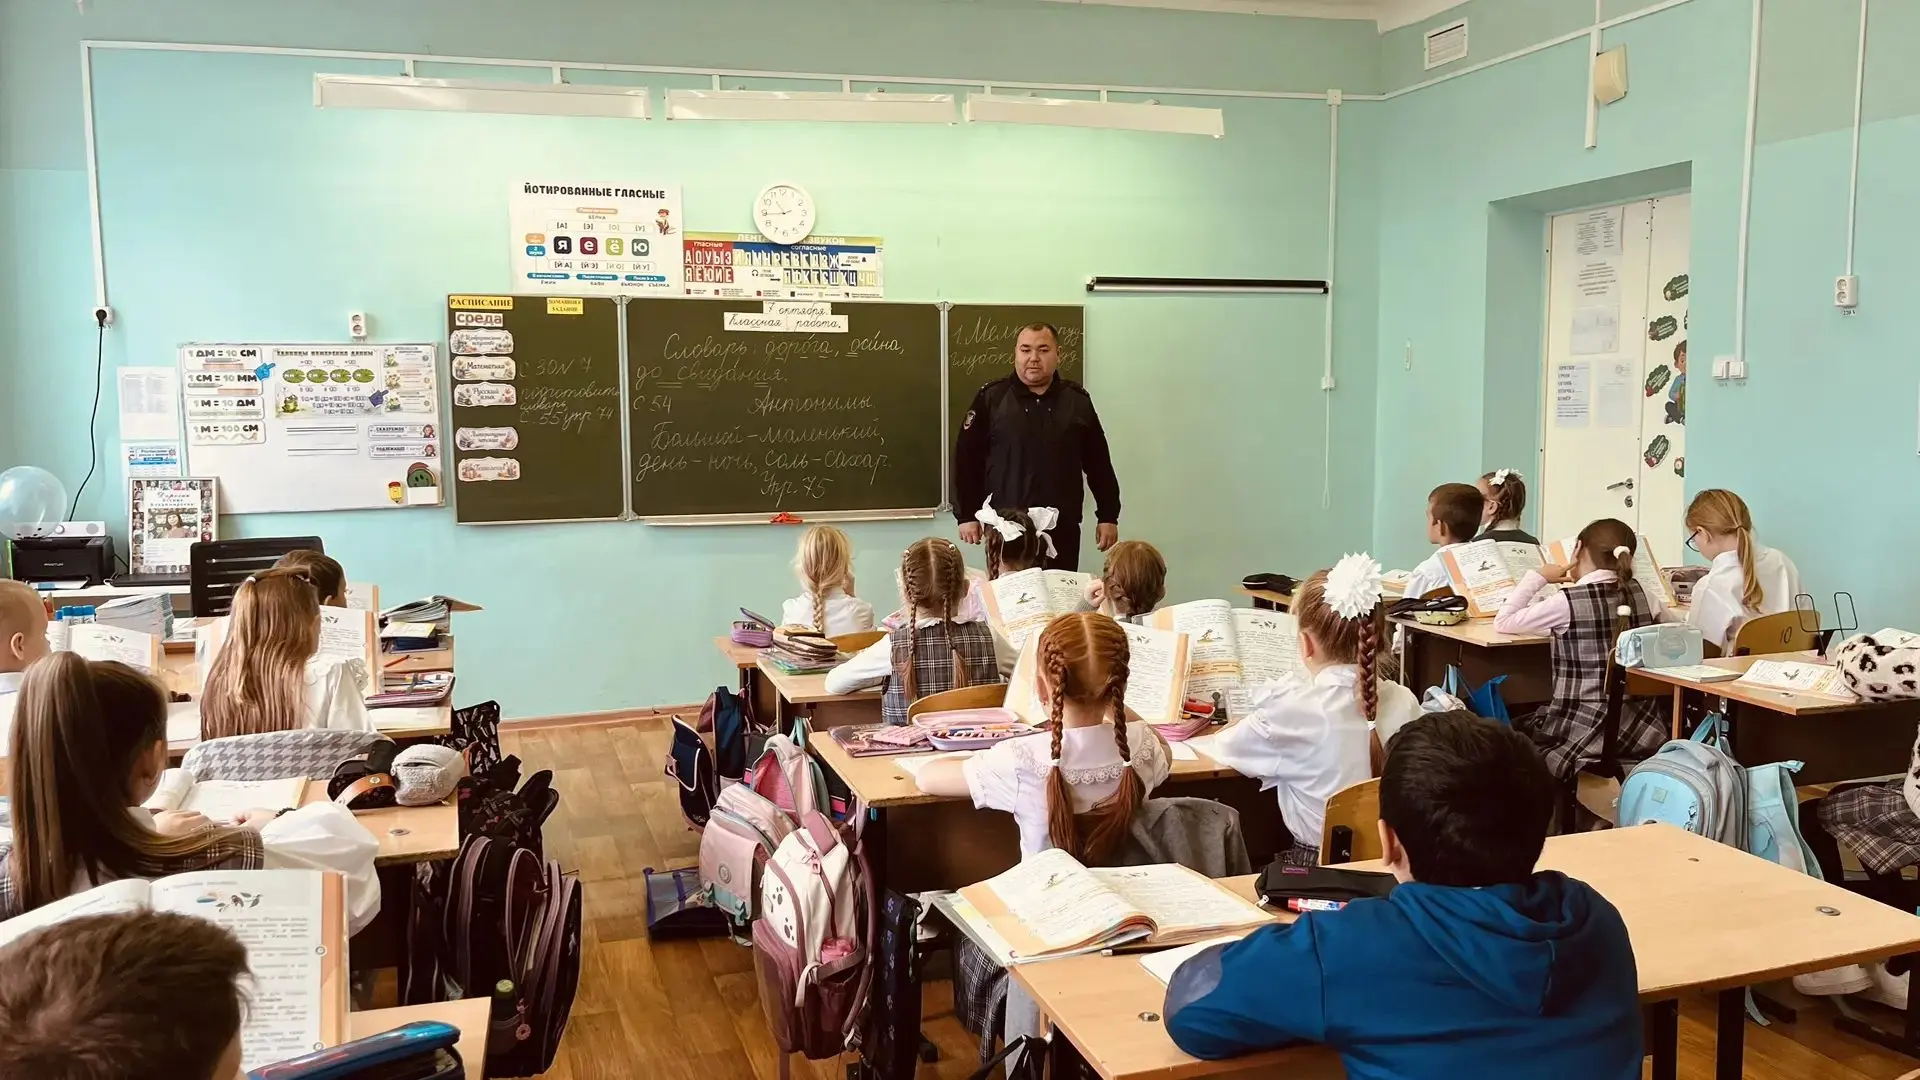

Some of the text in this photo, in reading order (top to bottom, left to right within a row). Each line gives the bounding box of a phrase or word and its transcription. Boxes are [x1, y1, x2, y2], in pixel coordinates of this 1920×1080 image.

[524, 182, 666, 199] ЙОТИРОВАННЫЕ ГЛАСНЫЕ
[450, 299, 512, 307] РАСПИСАНИЕ
[767, 302, 775, 313] 7
[457, 314, 502, 326] среда
[729, 314, 841, 332] Классная работа.
[196, 350, 216, 358] ДМ
[467, 362, 506, 370] Математика
[636, 366, 663, 391] до
[472, 388, 500, 396] Русский
[650, 395, 672, 414] 54
[201, 425, 211, 433] М
[243, 424, 259, 432] СМ
[803, 476, 834, 499] 75
[1779, 626, 1793, 644] 10
